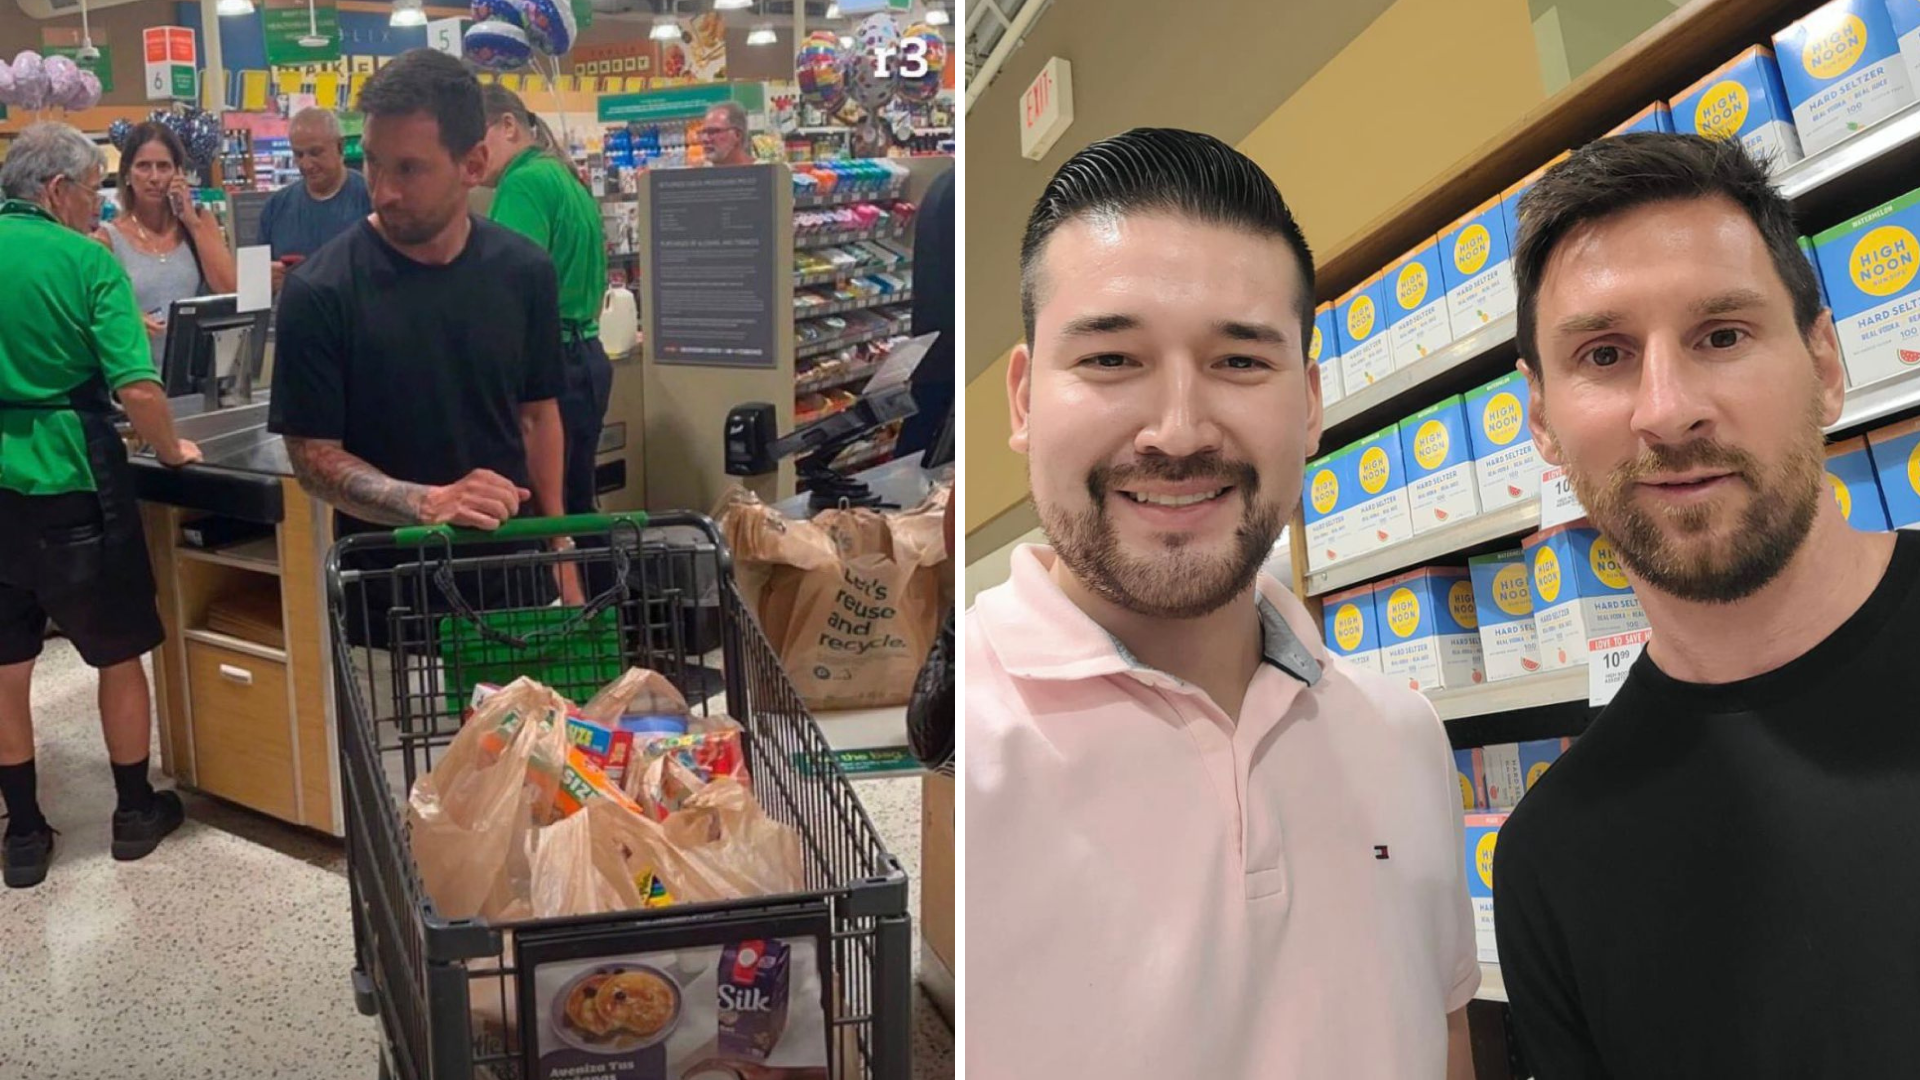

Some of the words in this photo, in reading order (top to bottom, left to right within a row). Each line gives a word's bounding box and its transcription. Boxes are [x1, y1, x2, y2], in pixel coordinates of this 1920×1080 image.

[439, 29, 450, 50] 5
[1812, 24, 1854, 54] HIGH
[1812, 35, 1859, 68] NOON
[576, 57, 648, 76] BAKERY
[154, 71, 163, 90] 6
[1809, 91, 1838, 112] HARD
[1840, 66, 1884, 94] SELTZER
[1026, 70, 1052, 128] EXIT
[1703, 91, 1737, 118] HIGH
[1847, 102, 1862, 114] 100
[1703, 102, 1742, 131] NOON
[1852, 205, 1893, 228] WATERMELON
[1460, 234, 1484, 254] HIGH
[1459, 244, 1486, 264] NOON
[1860, 239, 1906, 268] HIGH
[1860, 251, 1912, 282] NOON
[1400, 279, 1424, 299] NOON
[1401, 273, 1422, 289] HIGH
[1858, 310, 1890, 328] HARD
[1892, 296, 1920, 316] SELT
[1900, 327, 1918, 338] 100
[1488, 404, 1514, 422] HIGH
[1488, 414, 1518, 432] NOON
[1419, 431, 1442, 446] HIGH
[1418, 440, 1445, 457] NOON
[1486, 456, 1504, 468] HARD
[1505, 446, 1532, 461] SELTZER
[1364, 457, 1384, 472] HIGH
[1363, 467, 1386, 482] NOON
[1433, 470, 1458, 486] SELTZER
[1538, 560, 1554, 574] HIGH
[1598, 560, 1621, 571] NO
[1538, 572, 1558, 586] NOON
[836, 588, 896, 620] reuse
[1392, 600, 1413, 613] HIGH
[1454, 594, 1474, 603] HIG
[1594, 602, 1618, 610] HARD
[828, 610, 871, 636] and
[1338, 616, 1358, 628] HIGH
[1392, 611, 1416, 624] NOON
[1338, 624, 1360, 637] NOON
[1494, 626, 1518, 636] HARD
[818, 632, 906, 655] recycle.
[1595, 640, 1610, 649] LOVE
[1614, 636, 1622, 646] TO
[1626, 633, 1640, 644] SAVE
[1480, 904, 1494, 912] HAR
[718, 984, 772, 1012] Silk
[608, 1061, 635, 1071] Tus
